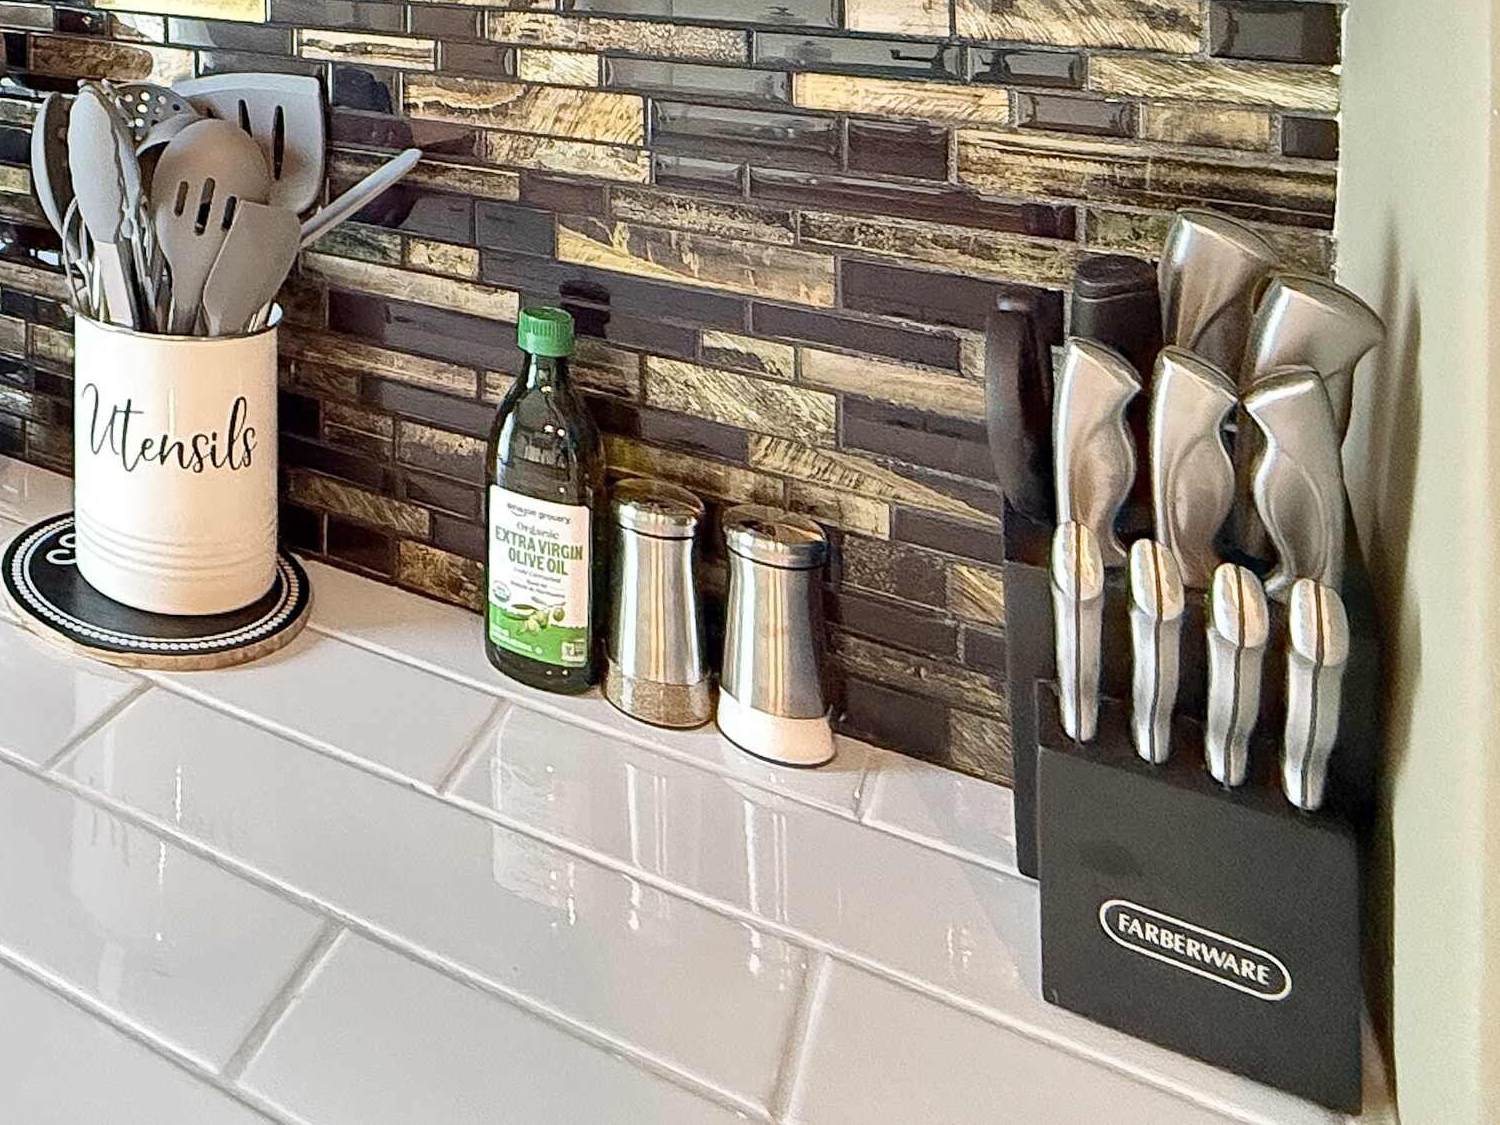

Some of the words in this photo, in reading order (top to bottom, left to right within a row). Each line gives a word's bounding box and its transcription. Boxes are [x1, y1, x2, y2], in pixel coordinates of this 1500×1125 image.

[81, 382, 258, 473] Utensils
[517, 521, 560, 540] Organic
[538, 511, 572, 525] grocery
[495, 525, 536, 553] EXTRA
[538, 539, 584, 561] VIRGIN
[508, 547, 545, 572] OLIVE
[546, 558, 569, 576] OIL
[1117, 912, 1271, 987] FARBERWARE
